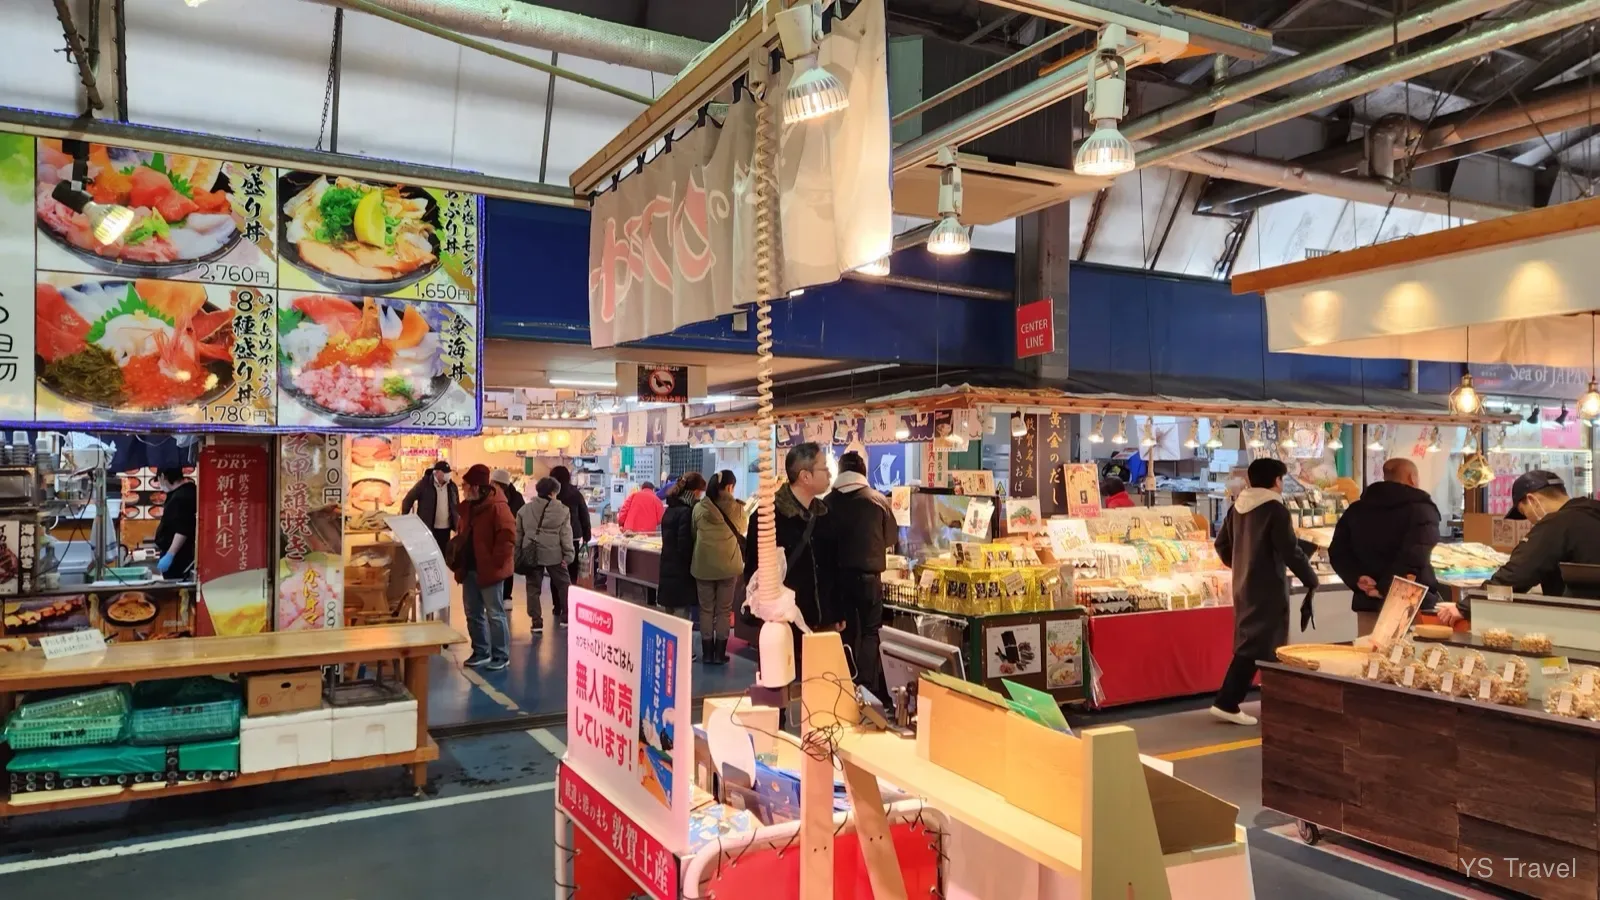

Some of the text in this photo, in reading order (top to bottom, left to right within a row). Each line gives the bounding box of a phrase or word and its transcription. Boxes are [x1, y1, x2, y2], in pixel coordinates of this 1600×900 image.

[197, 263, 270, 284] 2,760円
[414, 282, 470, 301] 1,650円
[1020, 318, 1048, 335] CENTER
[233, 290, 258, 403] 8種盛り丼
[1025, 334, 1044, 349] LINE
[1510, 363, 1534, 381] Sea
[1535, 367, 1549, 382] of
[201, 405, 267, 423] 1,780円
[410, 410, 471, 428] 2,230円
[1047, 410, 1062, 506] 黄金のだし
[576, 660, 632, 728] 無人販売
[612, 812, 669, 897] 敦賀土産
